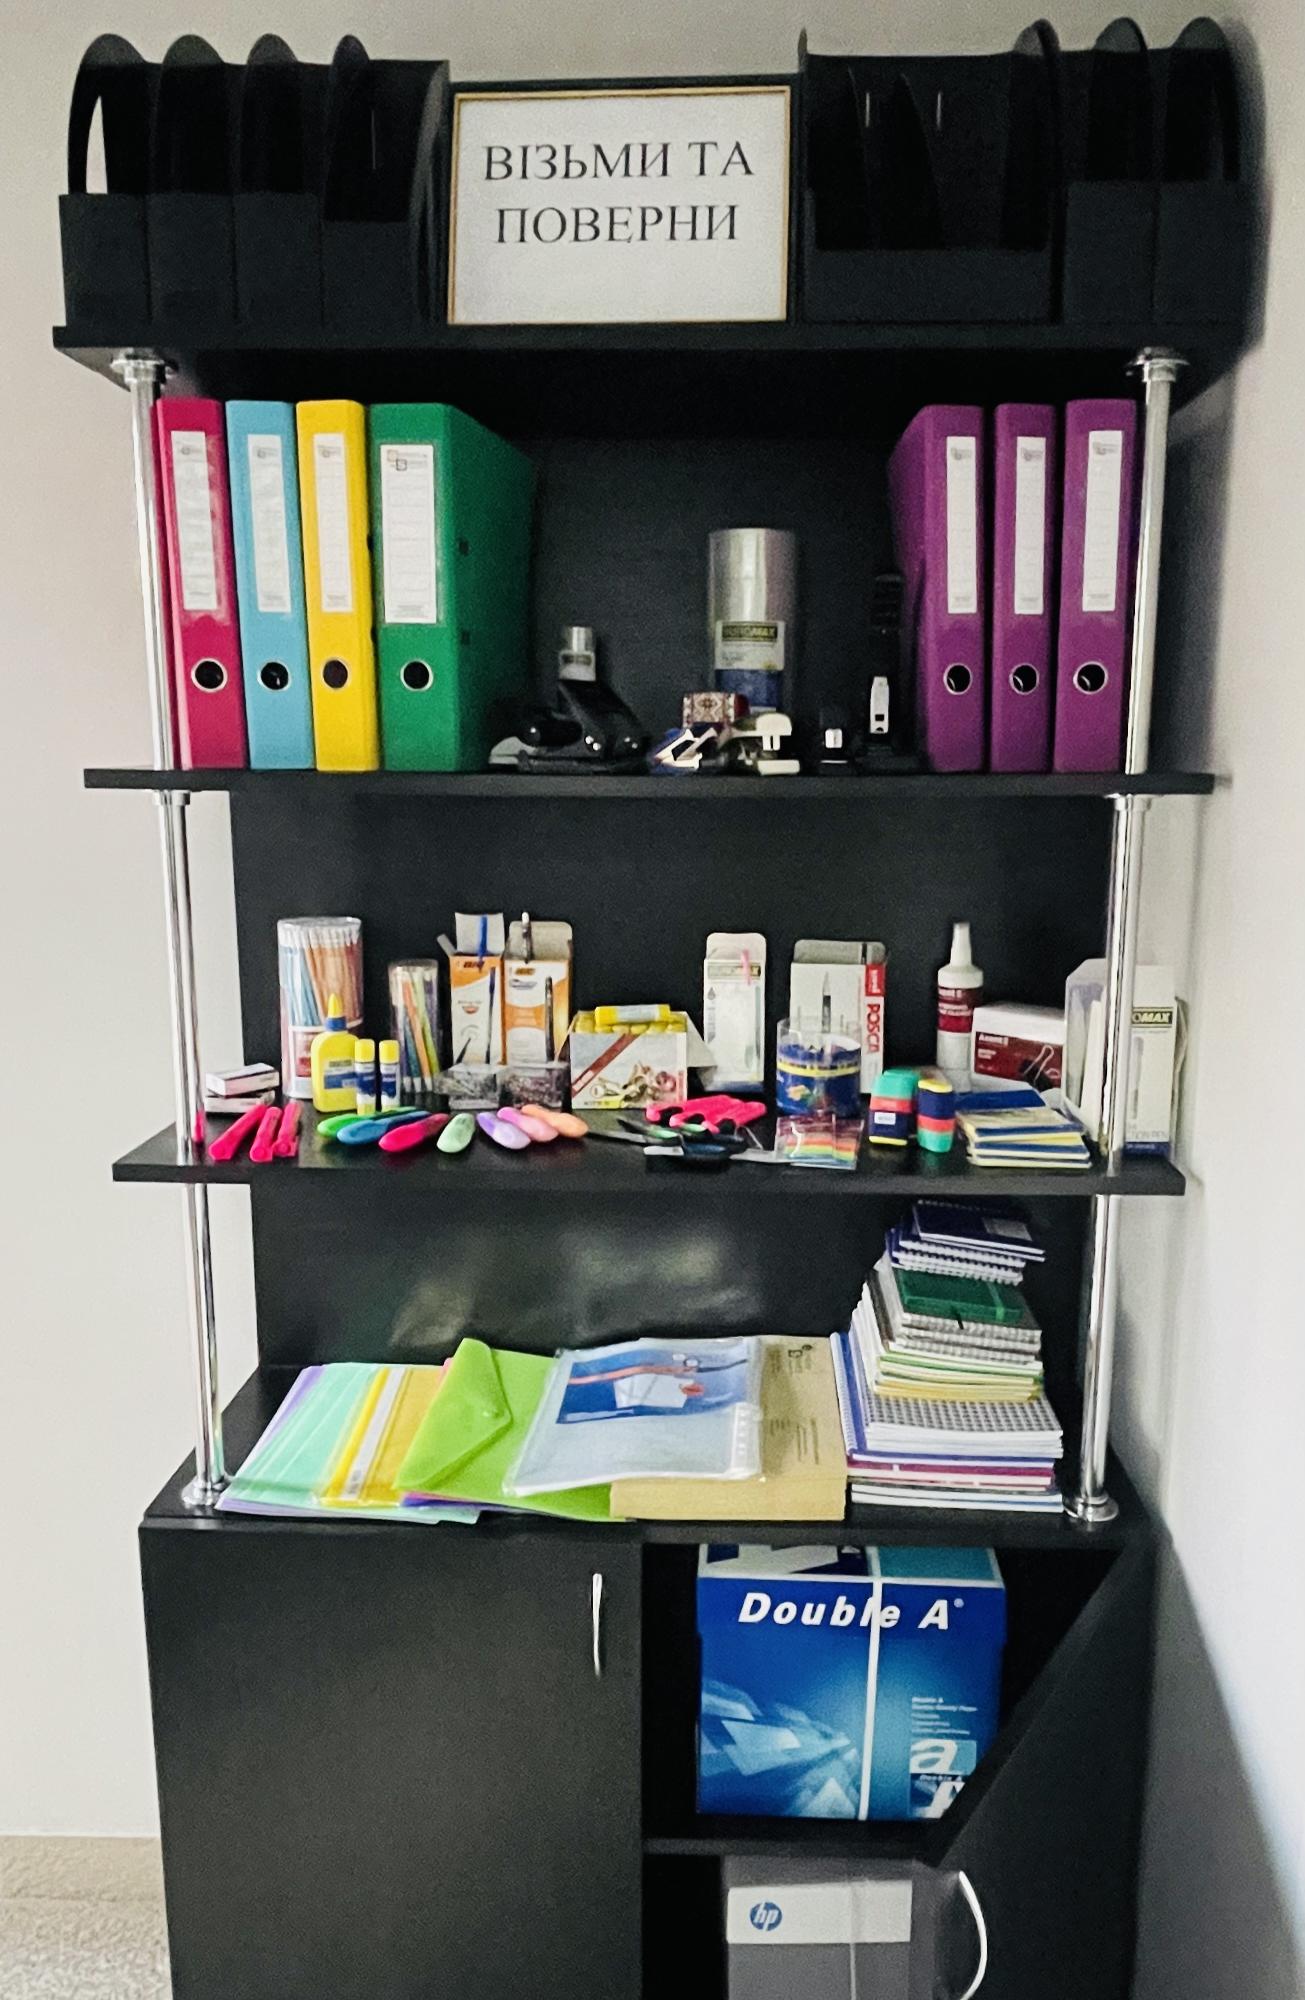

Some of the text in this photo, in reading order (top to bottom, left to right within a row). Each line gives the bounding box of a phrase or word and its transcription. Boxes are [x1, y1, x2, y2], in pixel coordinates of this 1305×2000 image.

[483, 140, 755, 181] ВІЗЬМИ ТА
[495, 204, 739, 244] ПОВЕРНИ
[867, 1003, 881, 1053] POSCA
[738, 1592, 901, 1629] Double
[753, 1901, 779, 1931] hp
